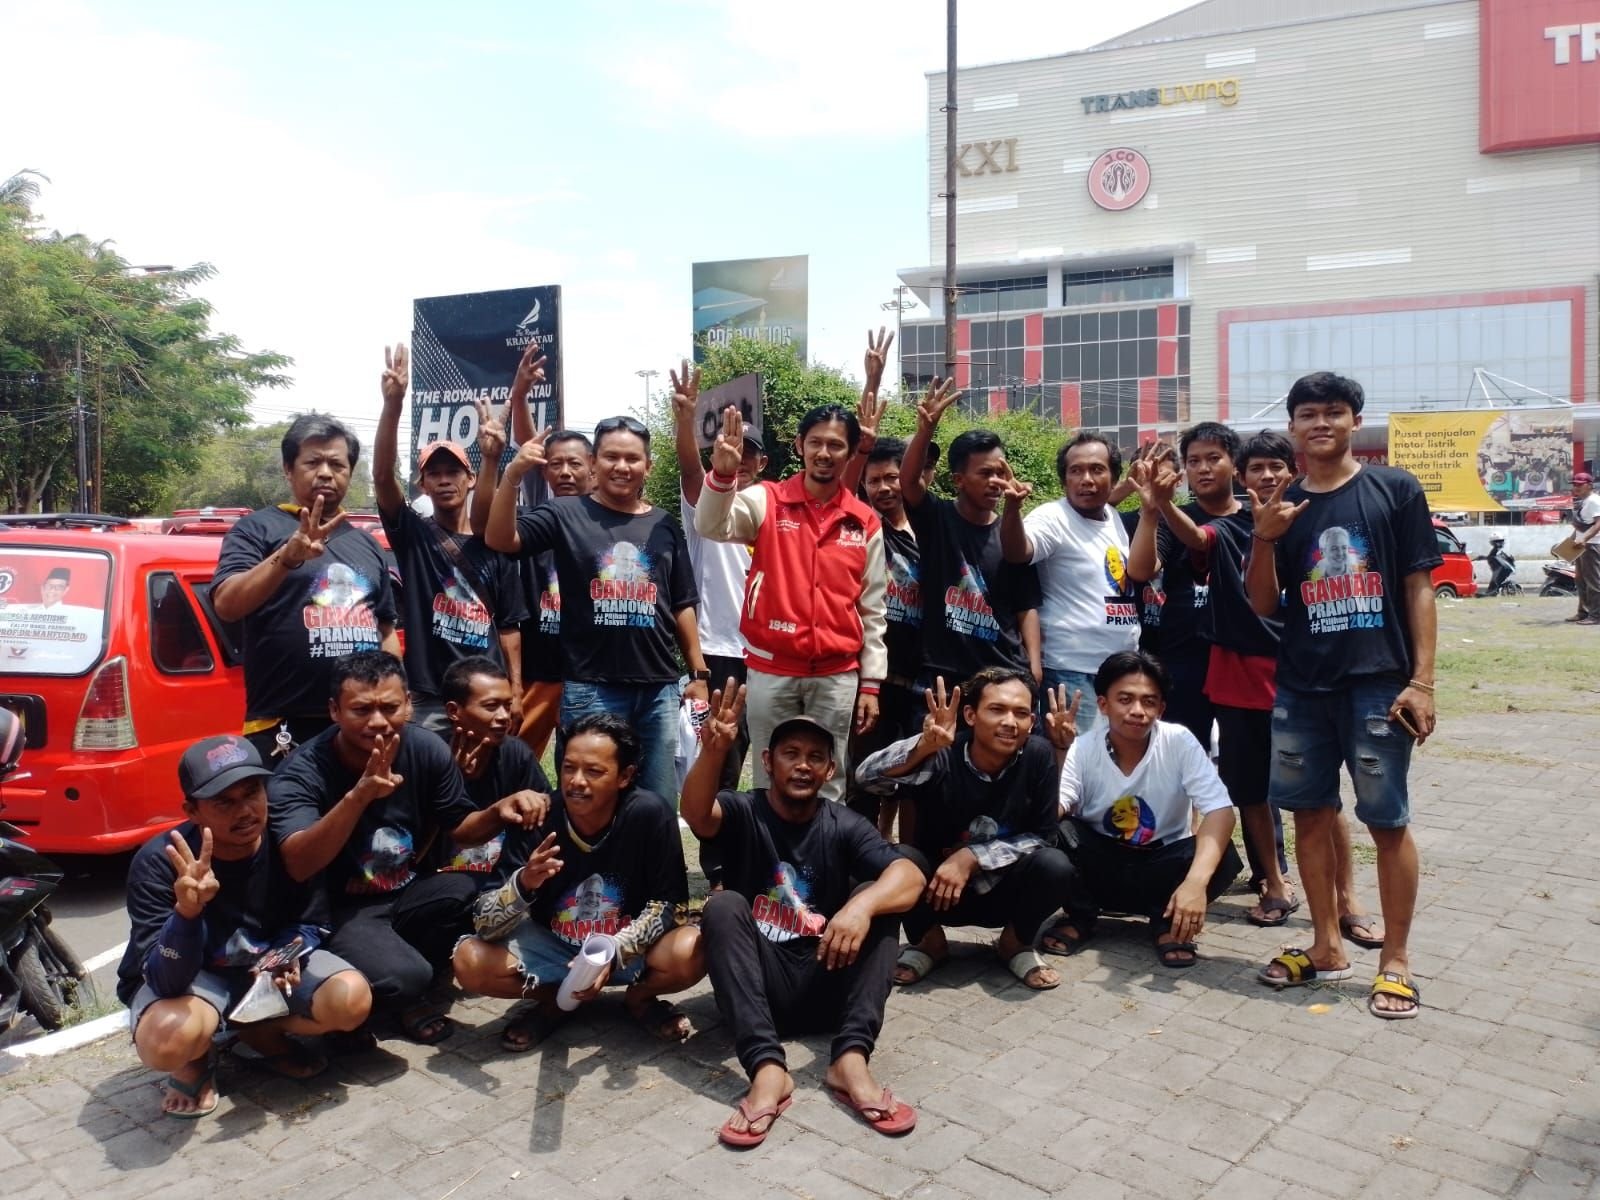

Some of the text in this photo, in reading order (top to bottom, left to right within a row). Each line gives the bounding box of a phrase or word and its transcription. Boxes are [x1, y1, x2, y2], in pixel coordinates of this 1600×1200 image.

[415, 384, 552, 404] THE ROYALE KRAATAU
[1394, 427, 1476, 439] Pusat penjualan
[1394, 439, 1456, 448] motor listrik
[1394, 450, 1469, 459] bersubsidi dan
[1432, 460, 1462, 469] listrik
[1415, 471, 1442, 480] urah
[590, 578, 657, 604] GANJAR
[1301, 571, 1384, 606] GANJAR
[1308, 596, 1383, 620] PRANOWO
[628, 614, 656, 628] 2024
[1350, 613, 1384, 628] 2024
